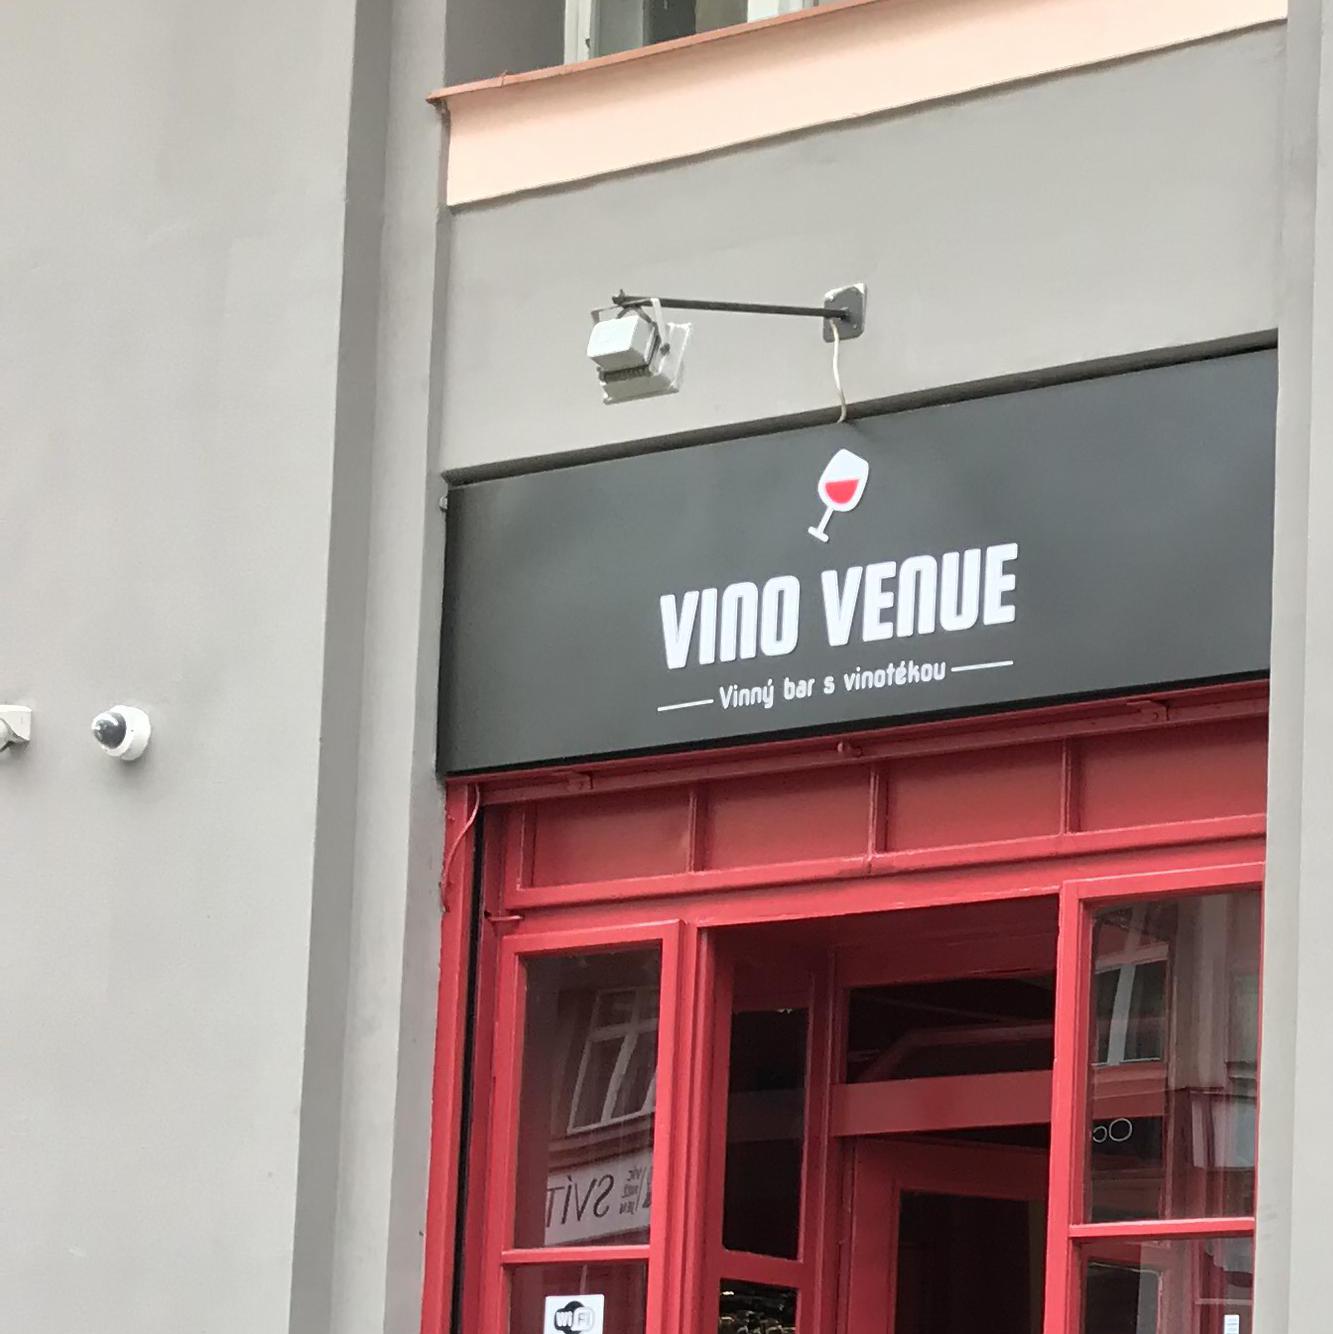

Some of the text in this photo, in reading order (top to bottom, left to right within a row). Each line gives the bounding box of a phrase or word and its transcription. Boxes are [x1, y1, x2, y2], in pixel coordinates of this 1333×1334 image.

[659, 542, 1019, 670] VINO VENUE
[719, 660, 947, 709] Vinný bar s vinotékou
